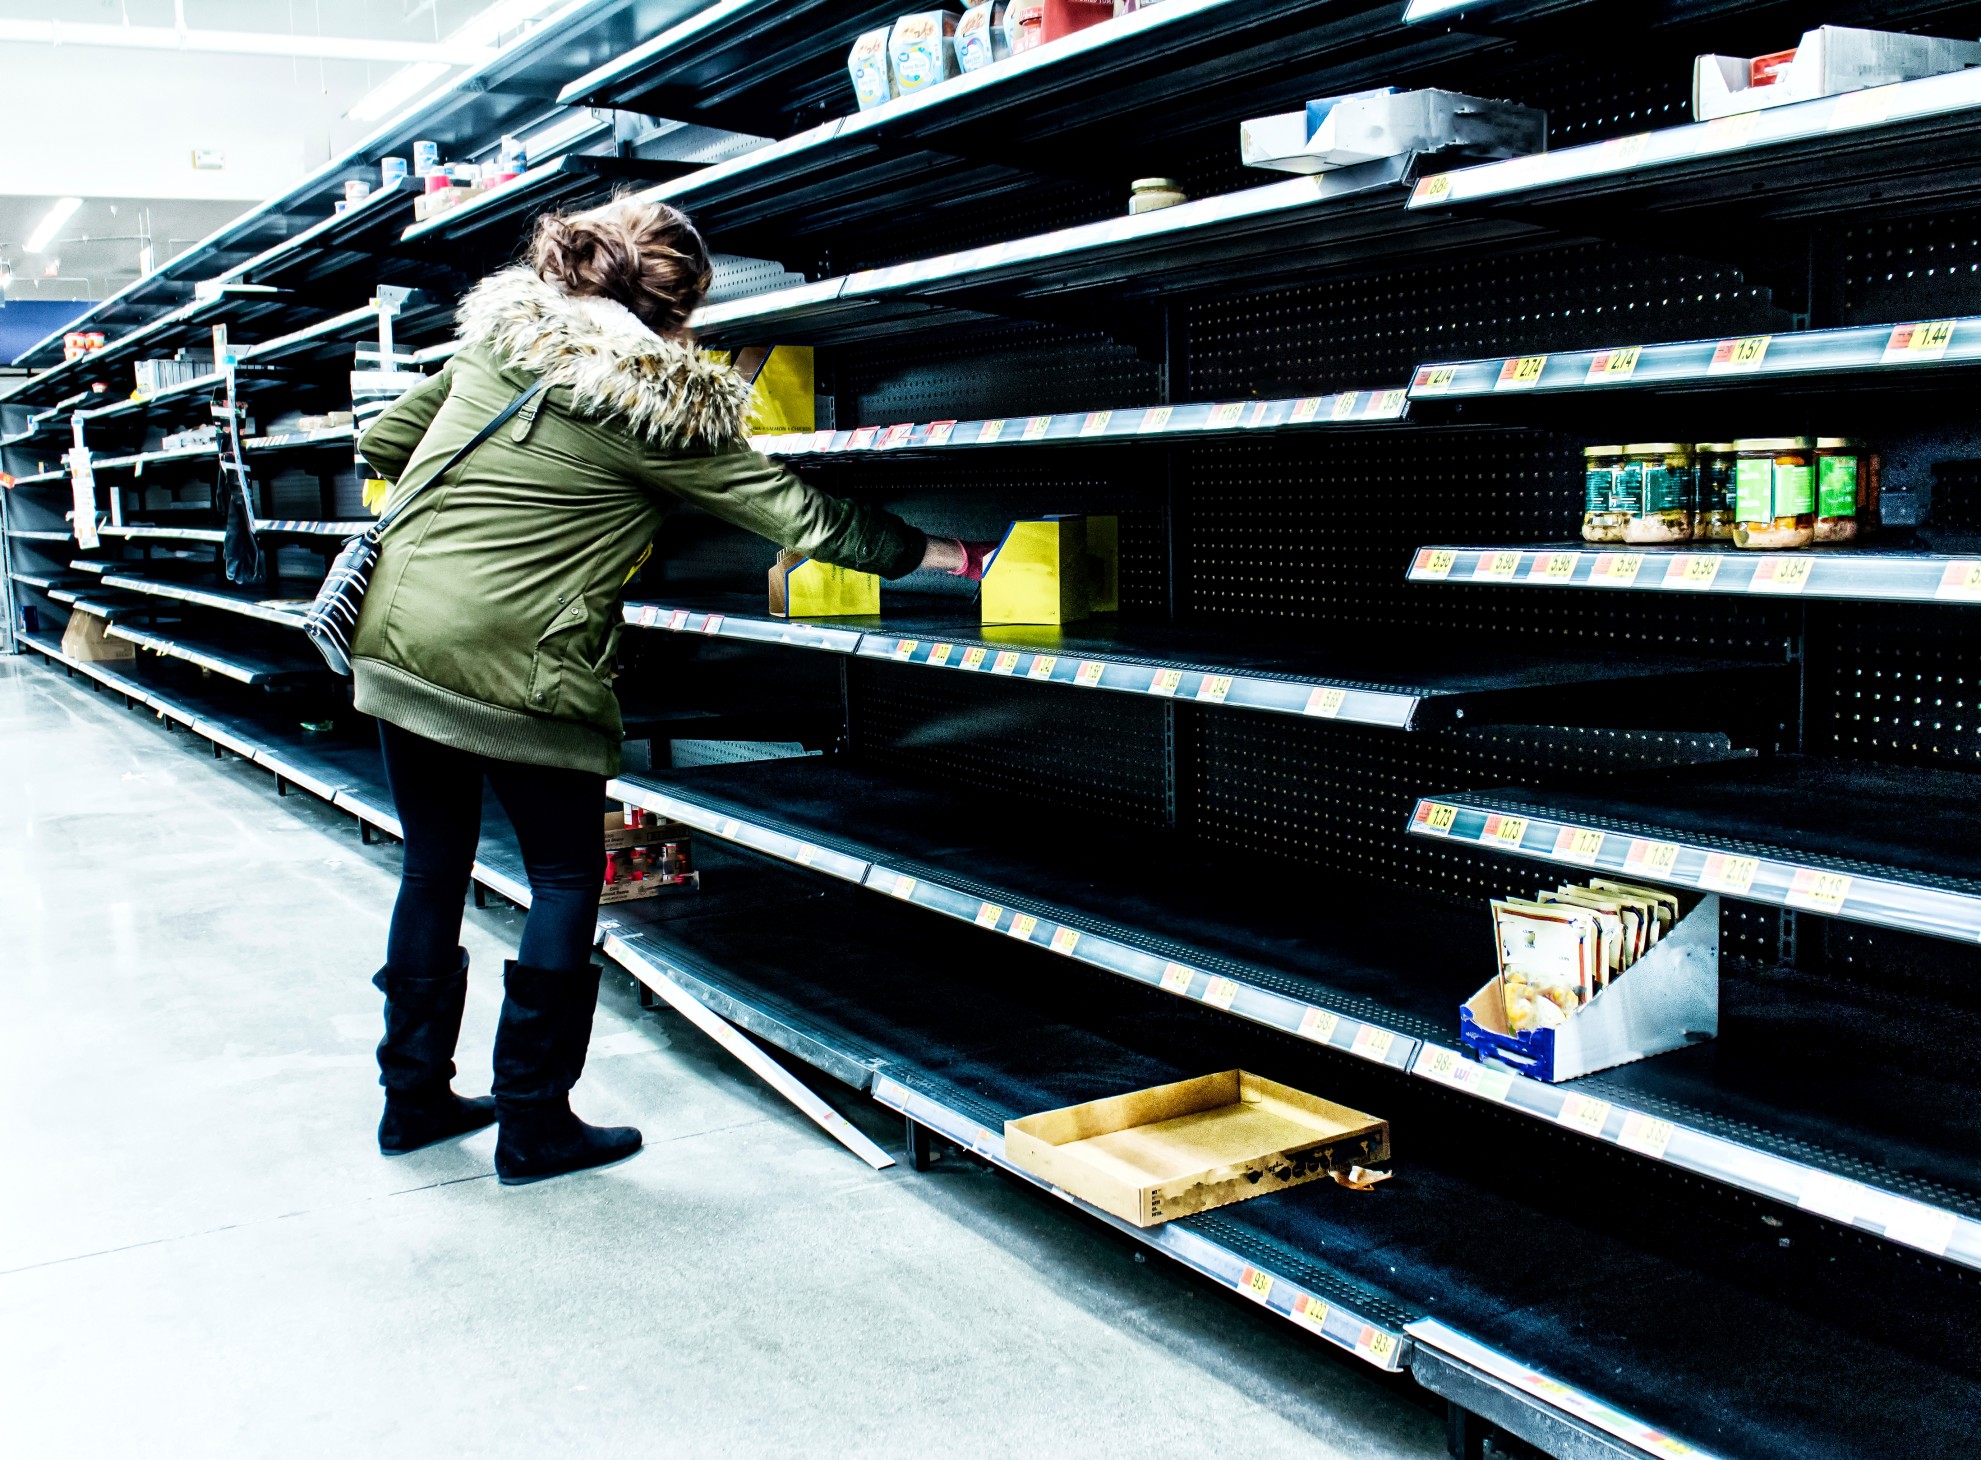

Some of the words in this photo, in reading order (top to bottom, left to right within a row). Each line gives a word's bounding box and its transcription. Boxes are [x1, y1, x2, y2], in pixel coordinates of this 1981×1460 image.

[1921, 323, 1951, 346] 1.44
[1611, 349, 1638, 370] 2.74
[1717, 338, 1763, 361] 1.57
[1519, 358, 1542, 378] 2.74
[1433, 552, 1452, 568] 5.98
[1495, 554, 1515, 570] 5.98
[1550, 555, 1572, 572] 5.98
[1617, 555, 1642, 572] 5.98
[1692, 556, 1717, 576] 5.98
[1780, 559, 1810, 578] 3.84
[1433, 809, 1452, 826] 1.73
[1501, 820, 1521, 840] 1.73
[1578, 834, 1600, 853] 1.73
[1650, 845, 1674, 867] 1.82
[1309, 1300, 1328, 1322] 2.22
